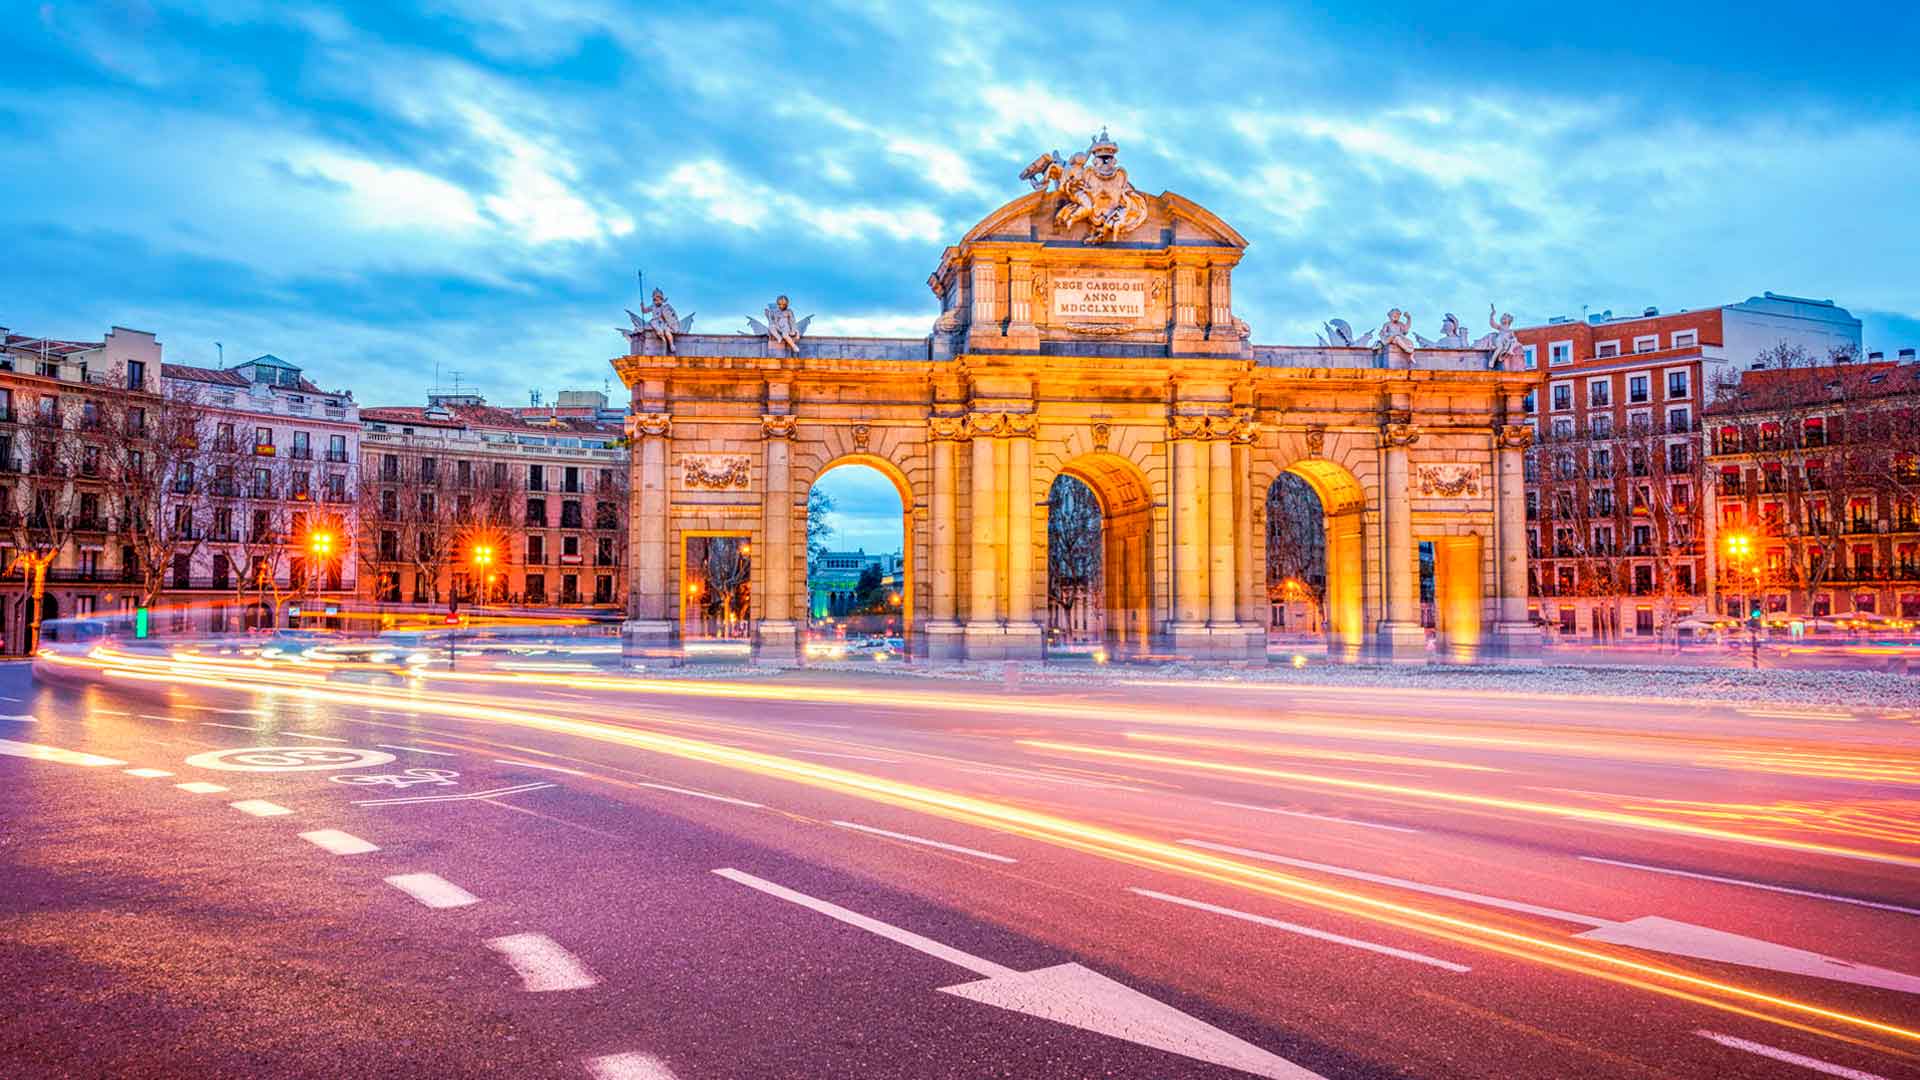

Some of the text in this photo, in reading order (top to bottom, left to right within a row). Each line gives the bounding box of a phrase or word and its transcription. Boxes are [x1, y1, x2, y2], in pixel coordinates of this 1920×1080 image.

[1055, 281, 1144, 292] REGE CAROLO III
[1083, 293, 1117, 302] ANNO
[1060, 303, 1138, 313] MDCCLXXVIII
